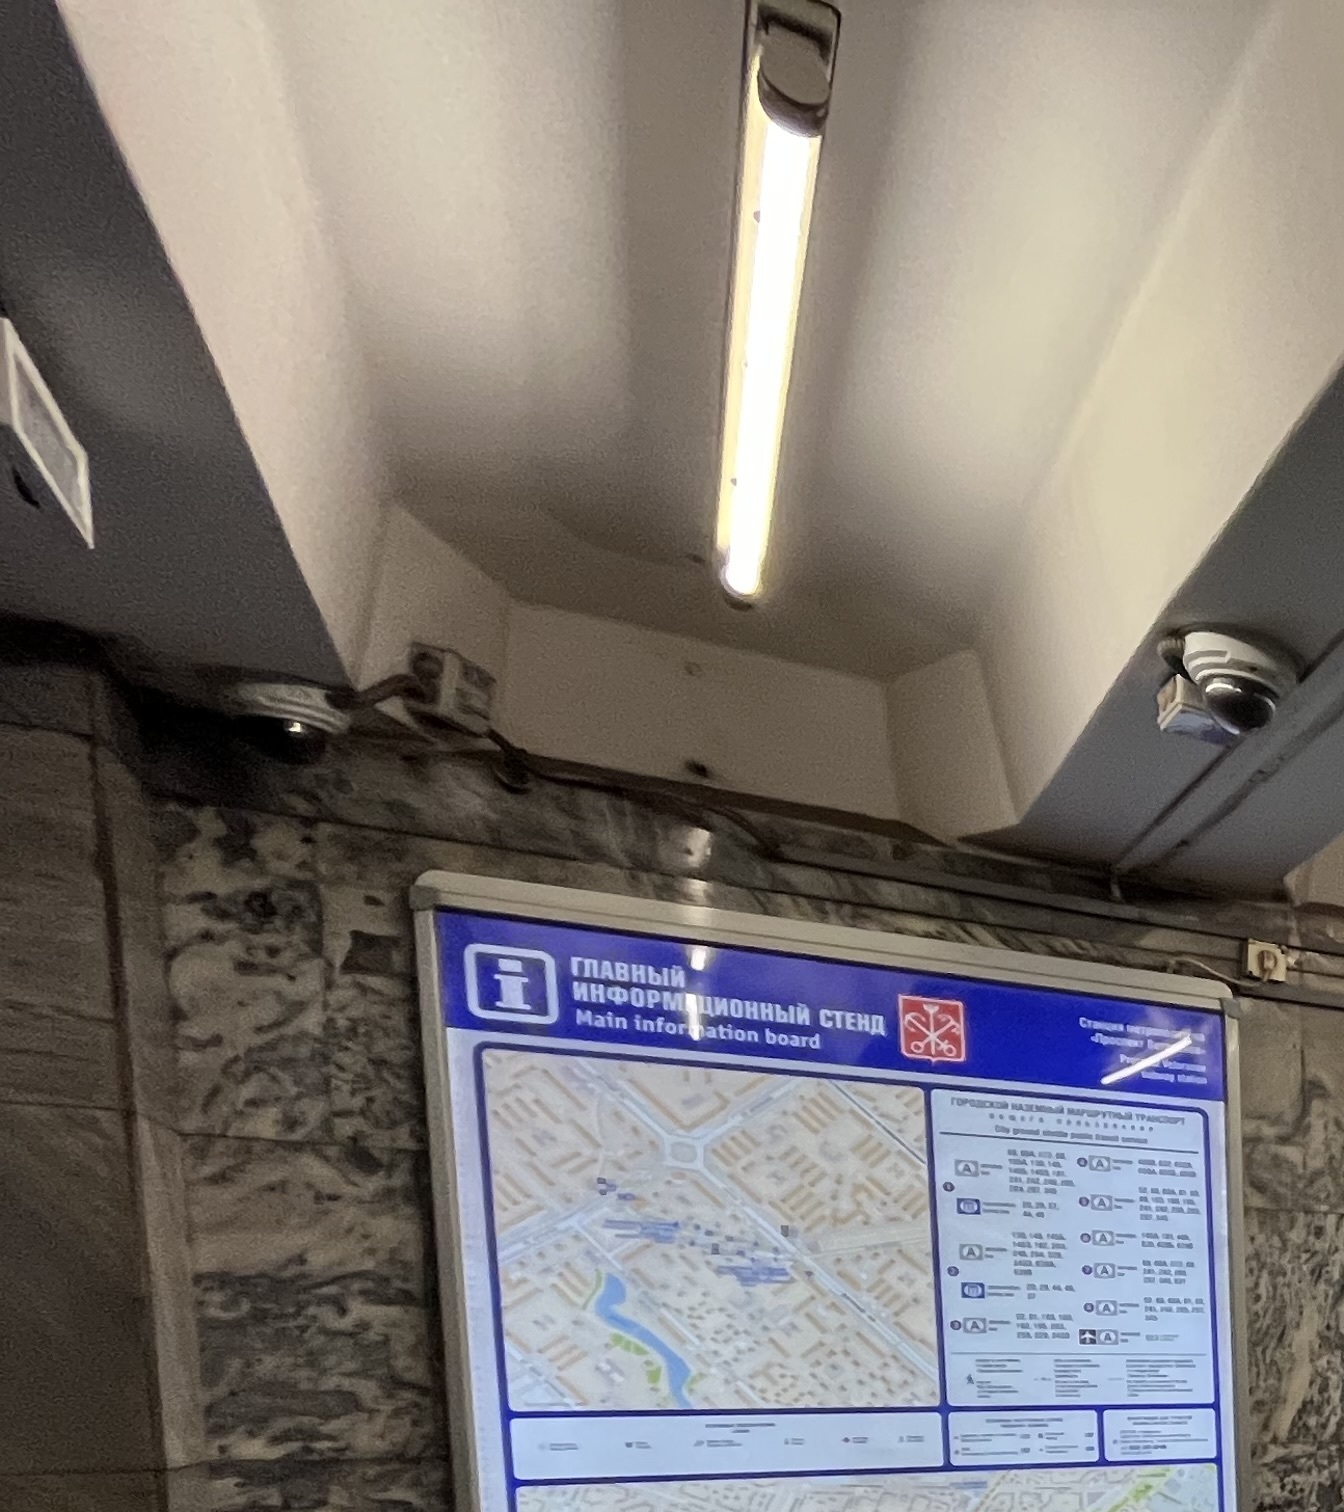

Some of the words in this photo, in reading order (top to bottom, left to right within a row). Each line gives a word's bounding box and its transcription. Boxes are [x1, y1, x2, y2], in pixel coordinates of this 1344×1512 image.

[570, 956, 686, 988] ГЛАВНЫЙ
[573, 981, 811, 1026] ИНФОРМЦИОННЫЙ
[819, 1008, 887, 1037] СТЕНД
[576, 1008, 628, 1030] Main
[765, 1028, 820, 1049] board
